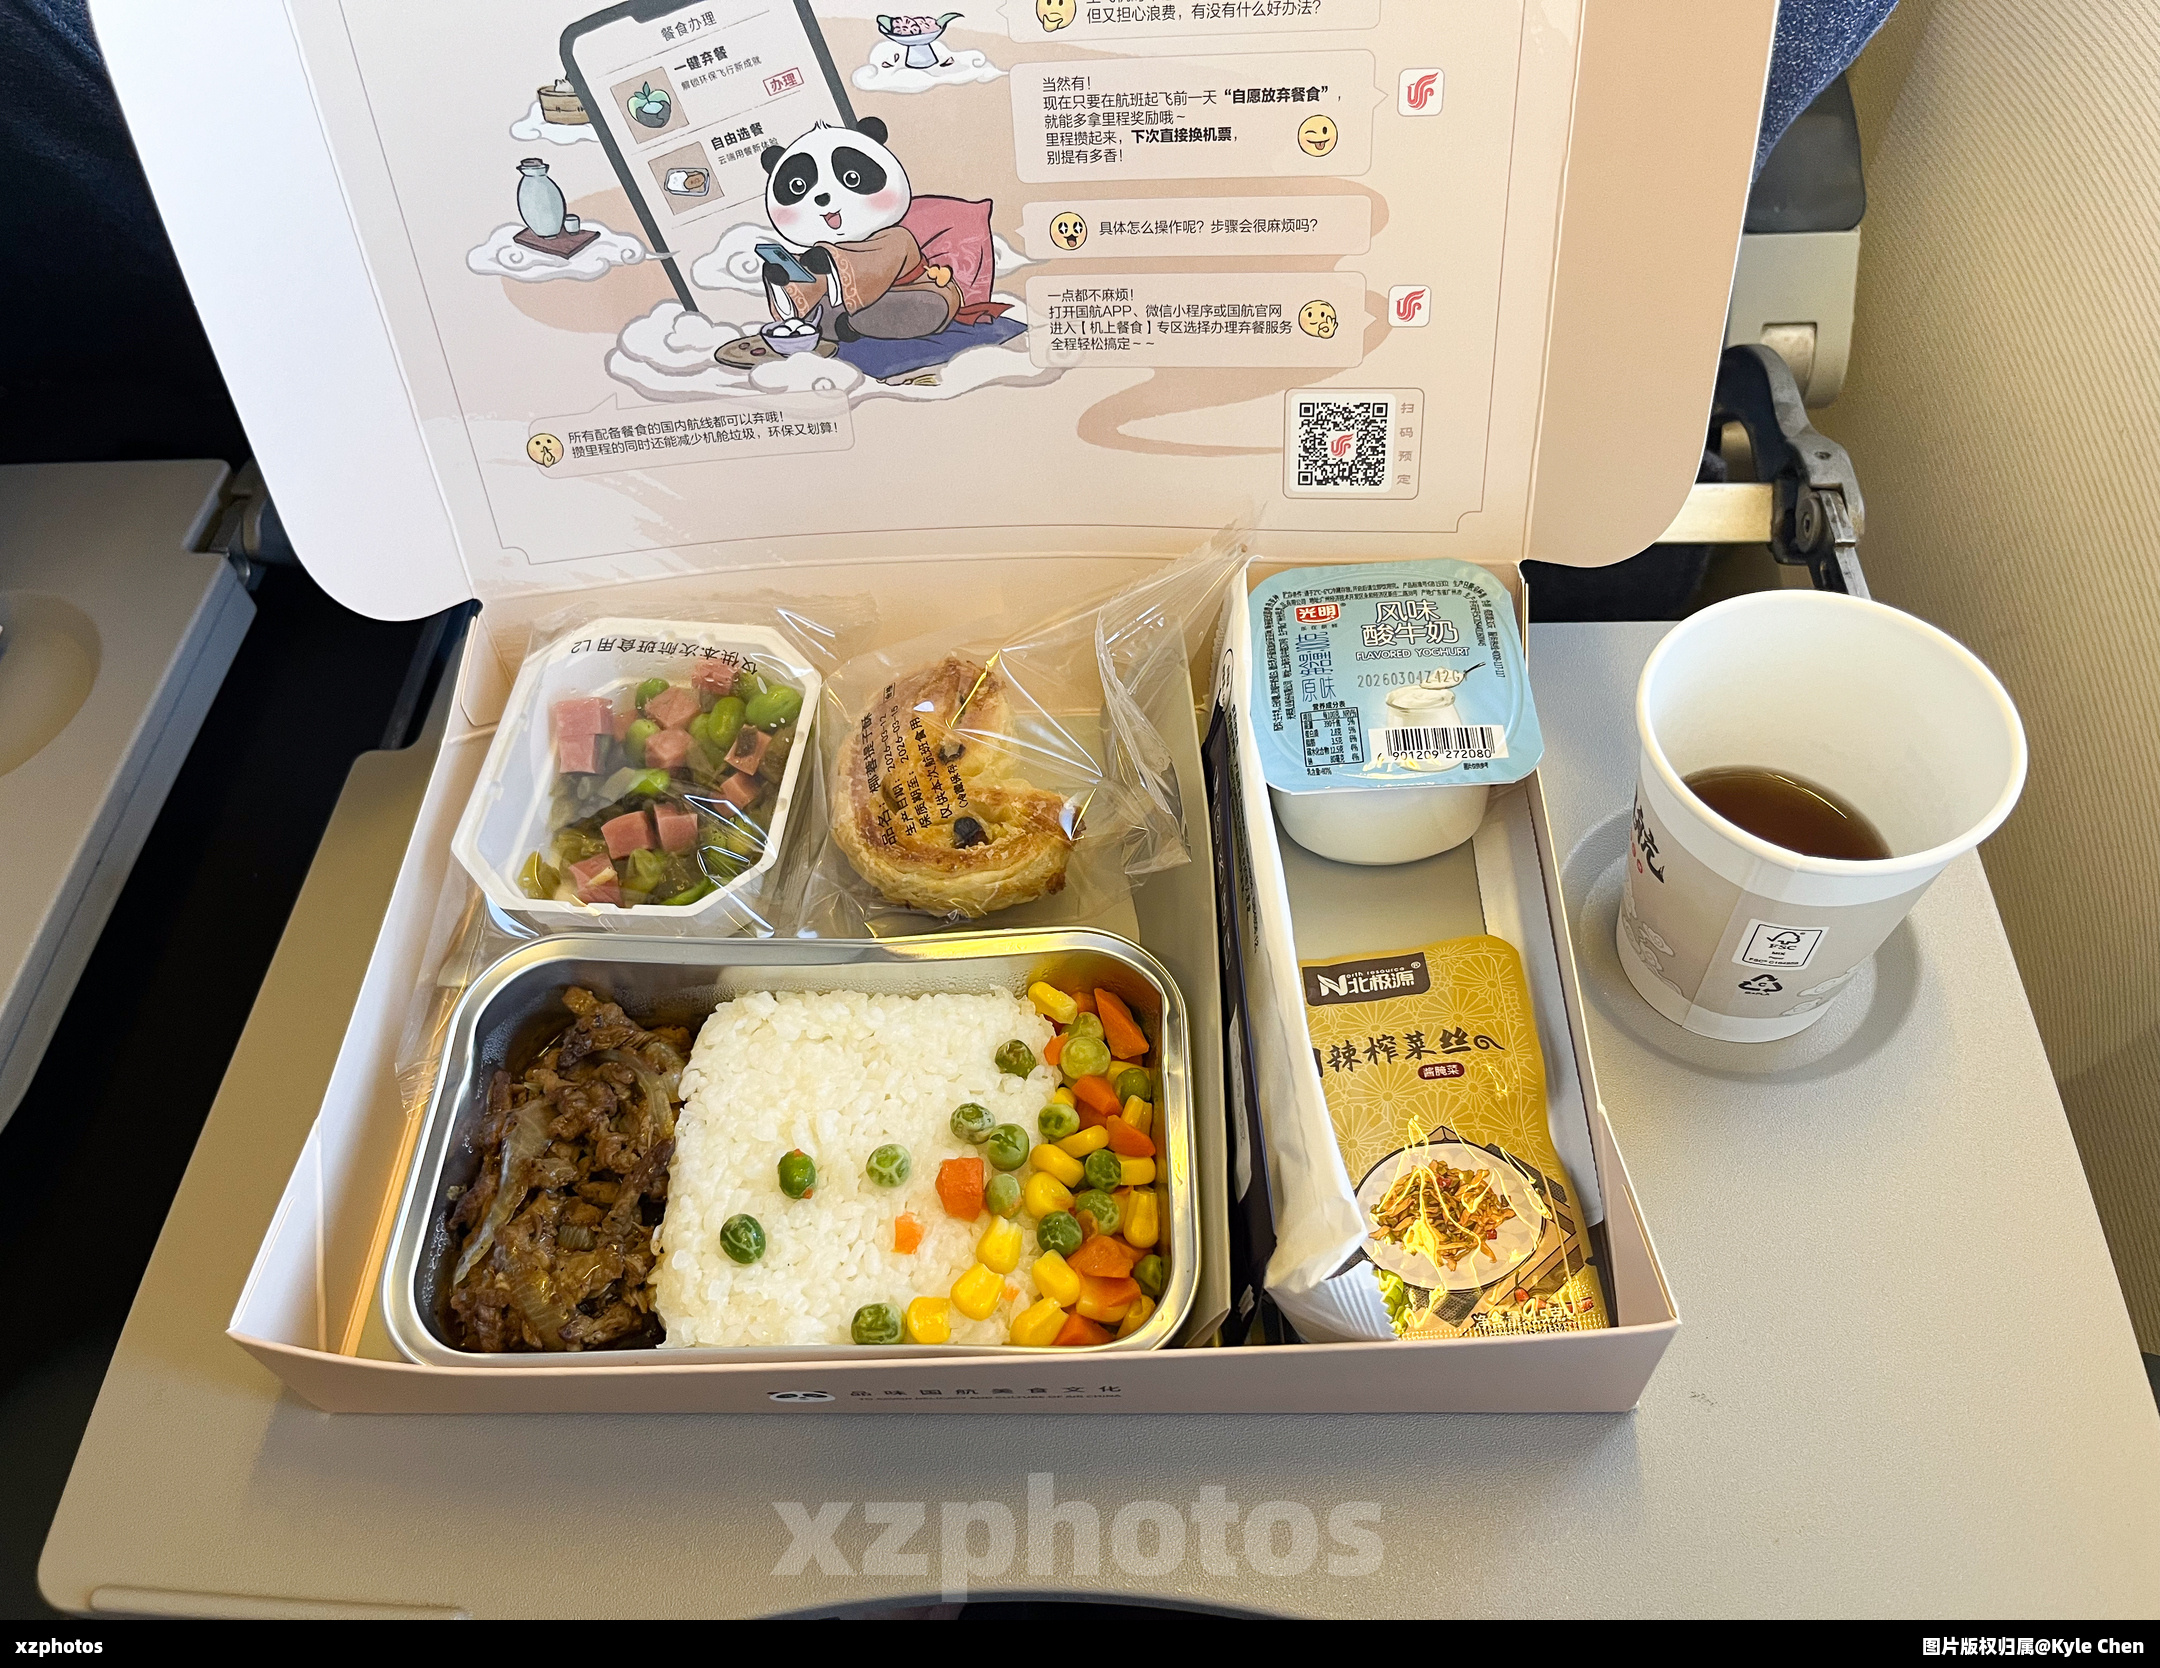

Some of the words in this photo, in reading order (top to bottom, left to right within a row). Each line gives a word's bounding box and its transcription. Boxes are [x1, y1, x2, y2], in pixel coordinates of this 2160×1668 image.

[1086, 0, 1322, 24] 但又担心浪费，有没有什么好办法？
[660, 11, 717, 41] 餐食办理
[674, 45, 729, 71] 一键弃餐
[680, 56, 762, 91] 解锁环保飞行新成就
[770, 73, 798, 93] 办理
[1042, 76, 1092, 92] 当然有！
[711, 122, 765, 151] 自由选餐
[1047, 149, 1124, 165] 别提有多香！
[1099, 218, 1318, 236] 具体怎么操作呢？步骤会很麻烦吗？
[1047, 288, 1134, 303] 一点都不麻烦！
[1048, 304, 1282, 319] 打开国航APP、微信小程序或国航官网
[568, 411, 785, 444] 所有配备餐食的国内航线都可以弃哦！
[572, 422, 839, 459] 攒里程的同时还能减少机舱垃圾，环保又划算！
[1299, 606, 1337, 620] 光明
[1375, 600, 1441, 624] 风味
[1361, 620, 1460, 647] 酸牛奶
[571, 639, 592, 654] L2
[597, 637, 758, 675] 仅供本次航班食用
[1356, 649, 1412, 661] FLAVORED
[1414, 647, 1471, 657] YOGHURT
[1302, 676, 1337, 702] 原味
[1312, 701, 1346, 711] 营养成分表
[879, 713, 896, 772] 2026-03-12
[891, 705, 909, 763] 2026-03-15
[1393, 750, 1439, 761] 901209
[1446, 749, 1492, 759] 272080
[909, 716, 953, 819] 仅供本次航班食用
[892, 778, 917, 837] 生产日期：
[908, 771, 933, 829] 保质期至：
[1768, 943, 1797, 951] FSC
[1348, 970, 1415, 994] 北极源
[1366, 966, 1405, 976] resource
[1312, 1026, 1472, 1078] 辣榨菜丝
[1423, 1065, 1460, 1078] 酱腌菜
[850, 1385, 1122, 1397] 品味国航美食文化
